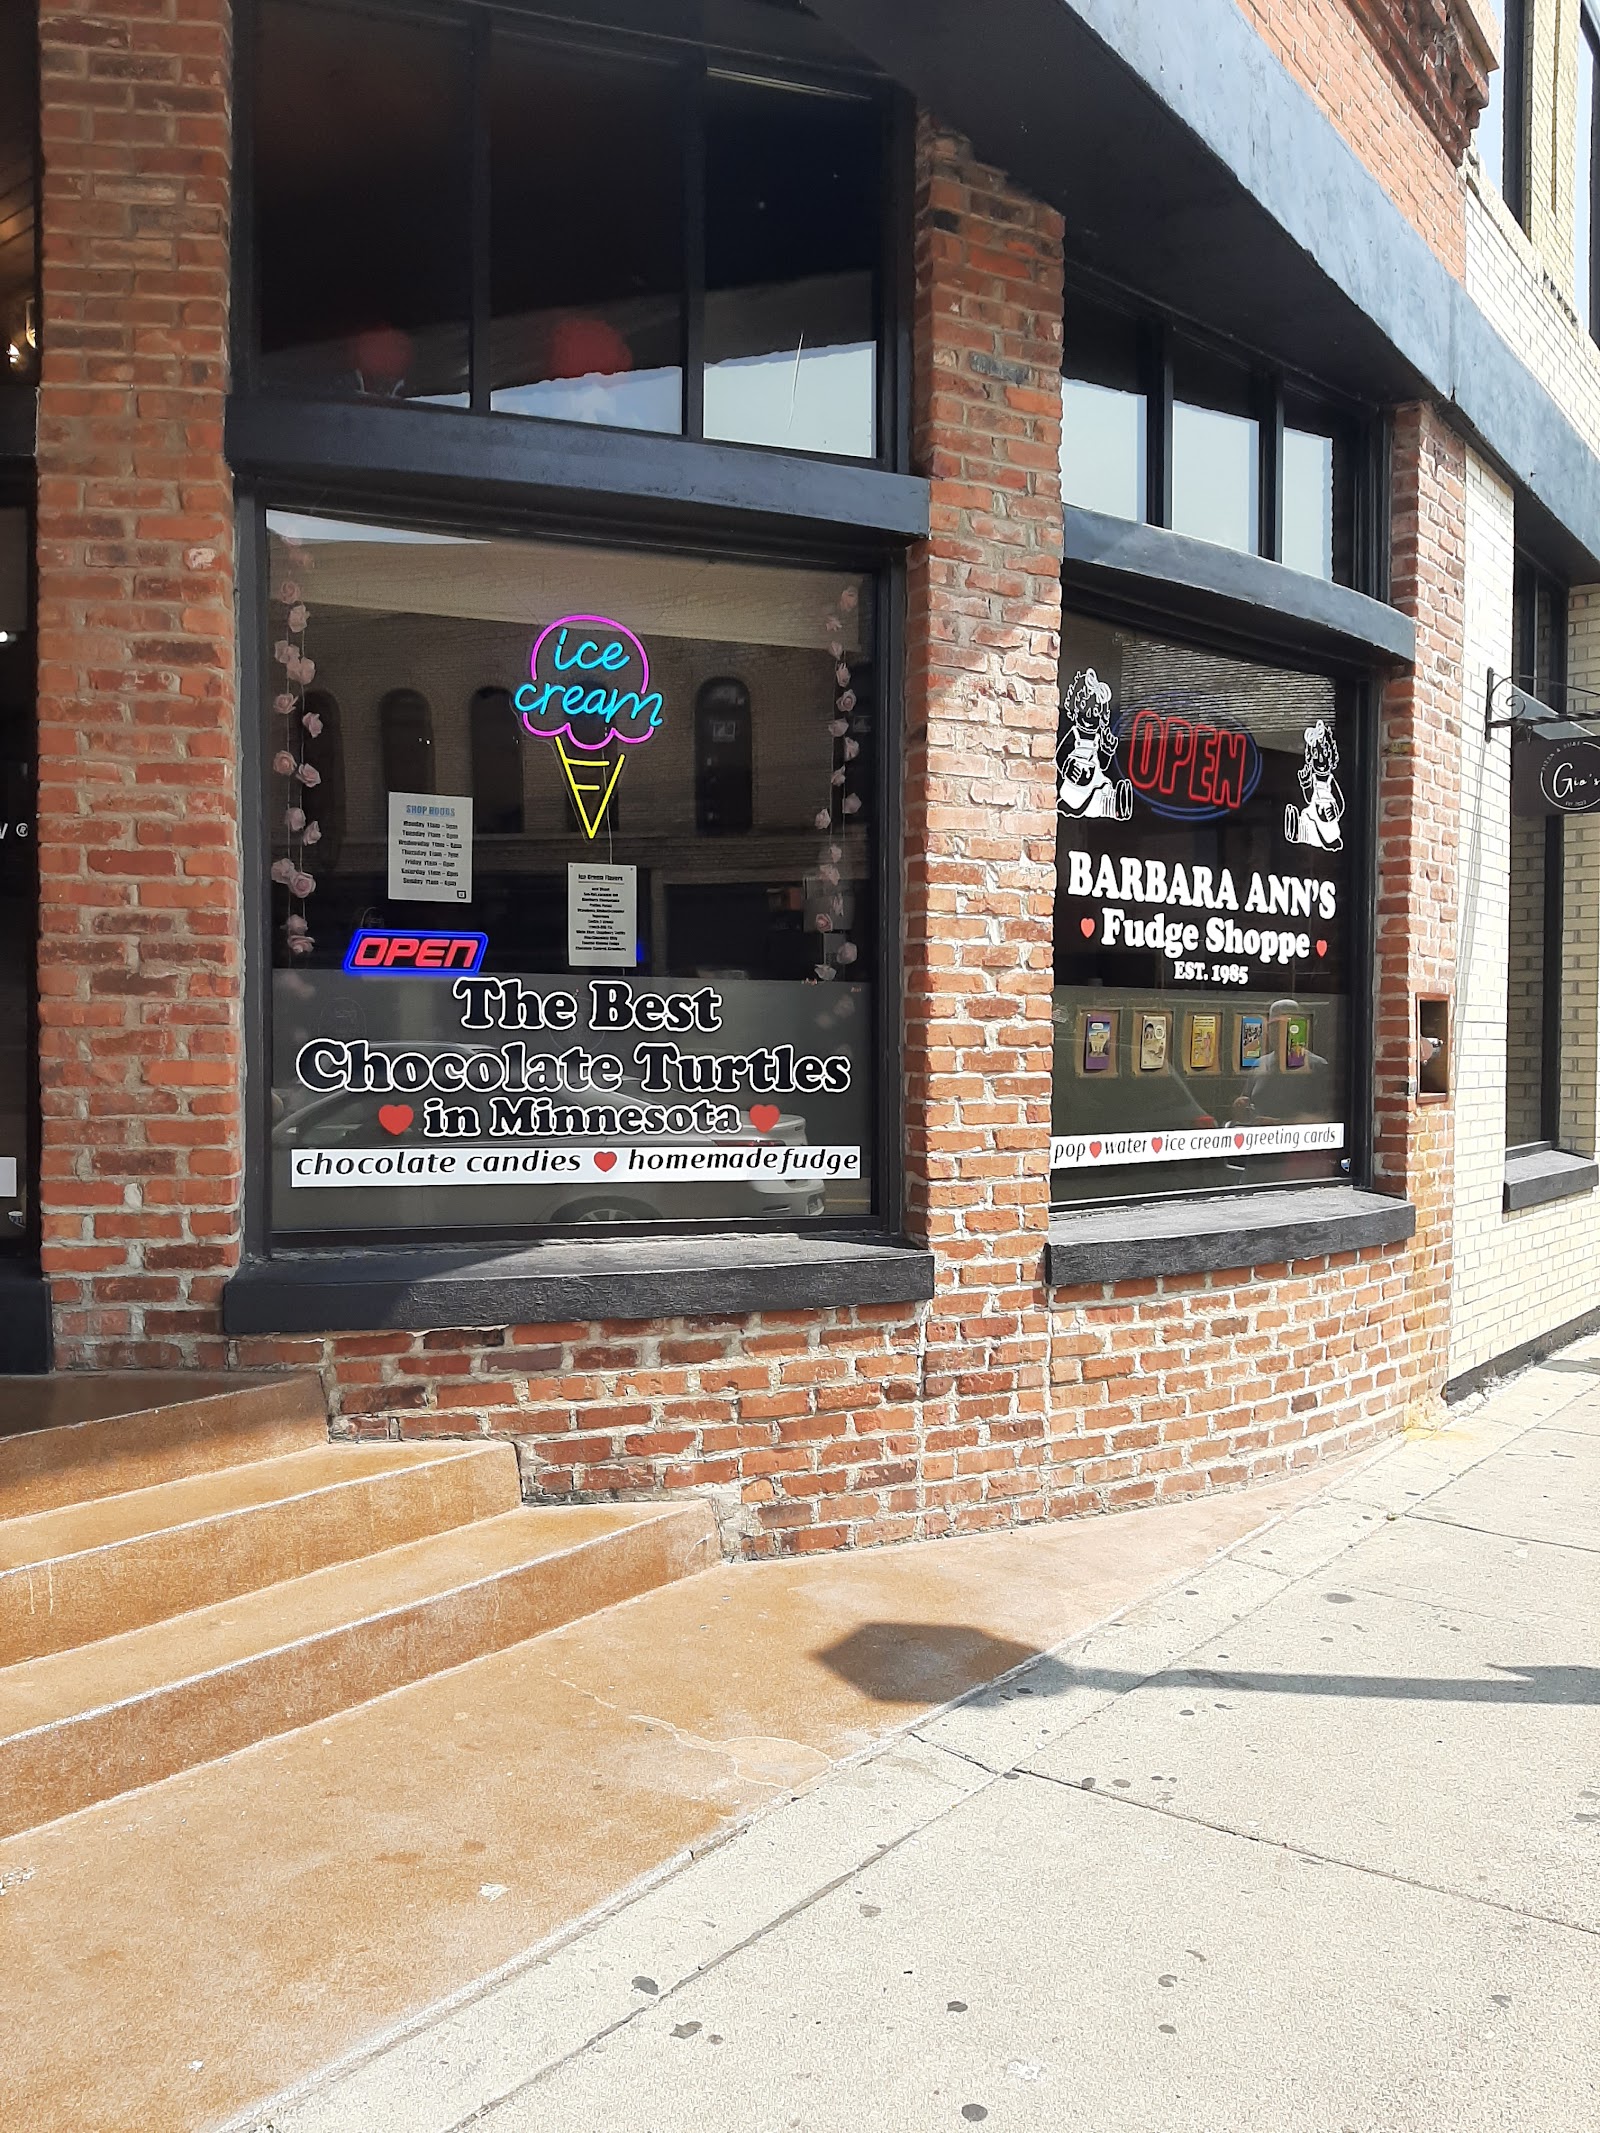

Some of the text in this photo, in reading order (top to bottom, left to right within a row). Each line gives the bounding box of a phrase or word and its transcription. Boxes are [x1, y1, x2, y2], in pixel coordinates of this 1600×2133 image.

[554, 628, 630, 670] ice
[514, 683, 663, 727] cream
[1128, 710, 1246, 808] OPEN
[406, 804, 428, 815] SHOP
[1068, 850, 1336, 920] BARBARA ANN'S
[354, 938, 478, 968] OPEN
[1101, 907, 1310, 964] Fudge Shoppe
[1174, 961, 1249, 984] EST. 1985
[453, 977, 722, 1032] The Best
[296, 1038, 851, 1093] Chocolate Turtles
[424, 1097, 742, 1137] in Minnesota
[296, 1152, 456, 1175] chocolate
[467, 1150, 581, 1173] candies
[1054, 1127, 1335, 1163] pop water ice cream greeting cards
